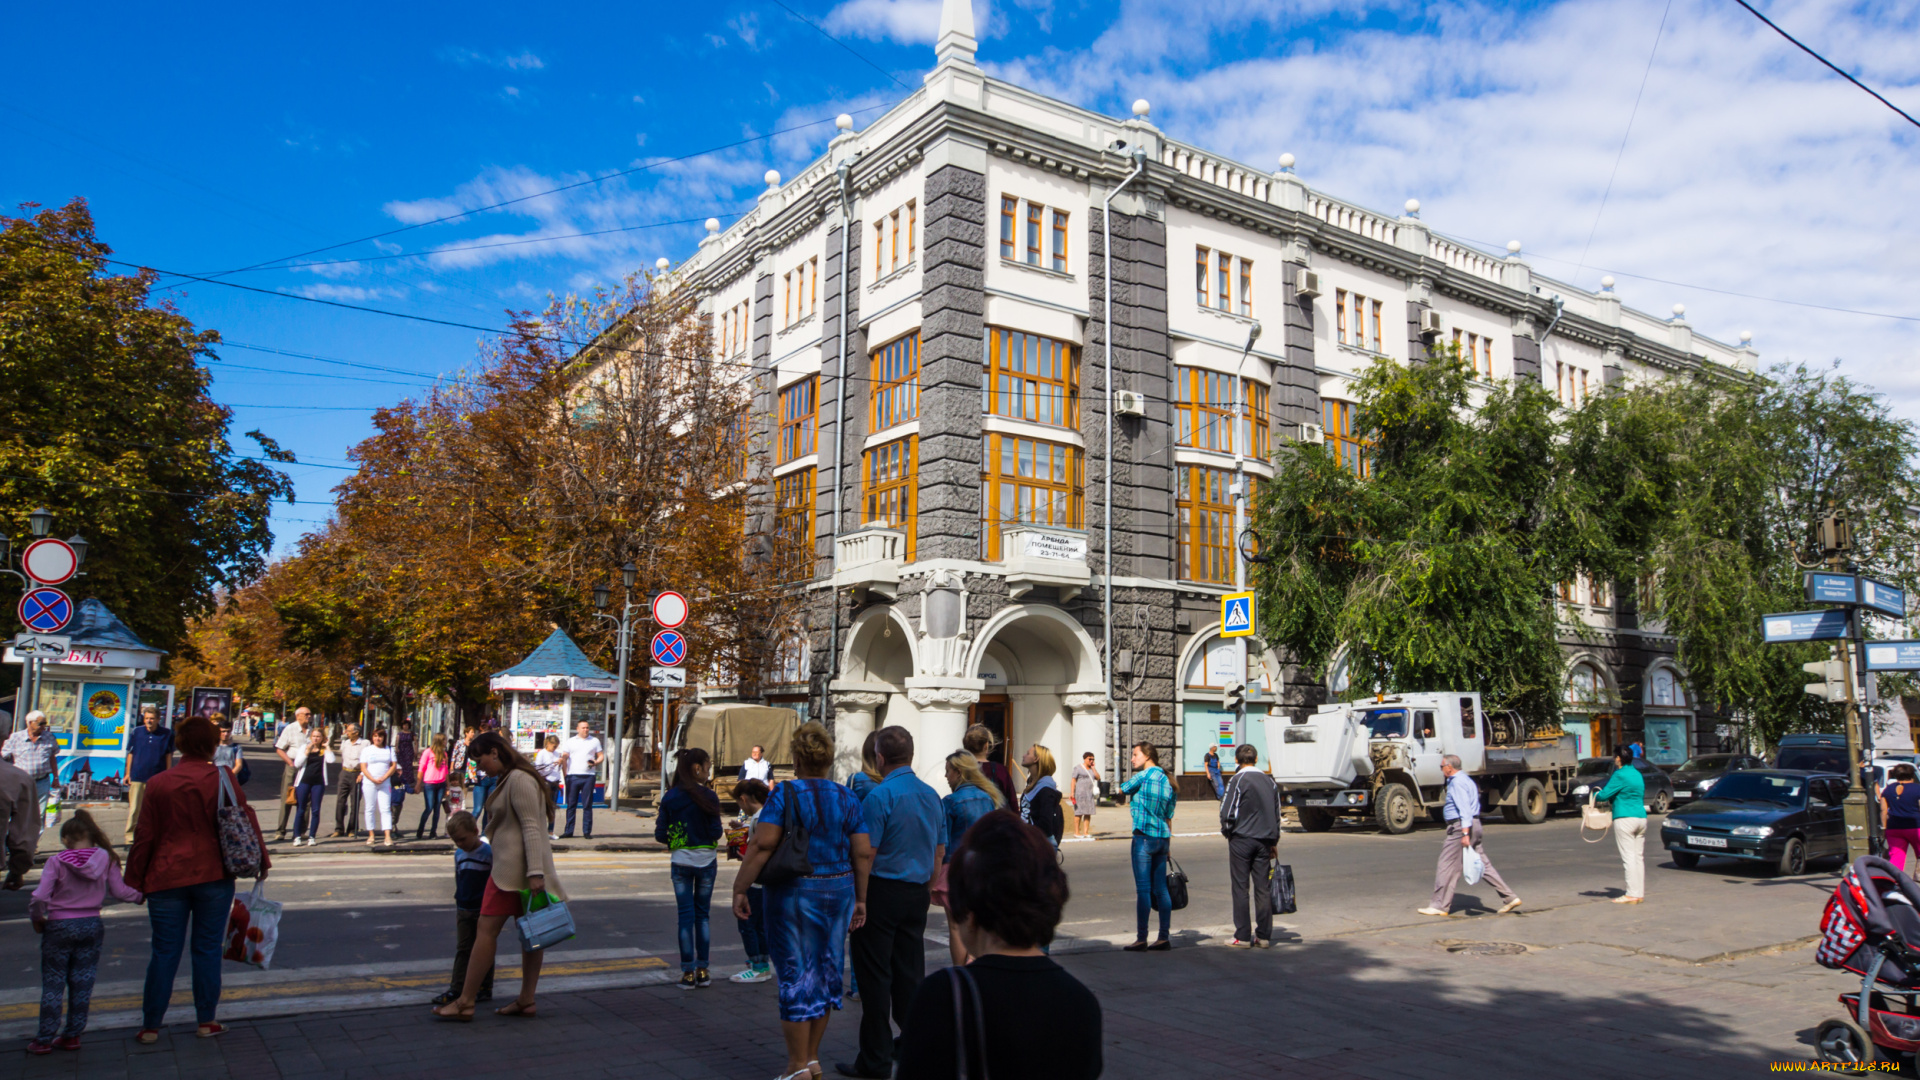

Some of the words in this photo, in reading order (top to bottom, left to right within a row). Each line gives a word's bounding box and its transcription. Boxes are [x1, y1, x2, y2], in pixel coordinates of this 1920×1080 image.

[1041, 535, 1069, 544] АРЕНДА
[1032, 541, 1079, 552] ПОМЕЩЕНИЙ
[49, 650, 108, 664] БАК
